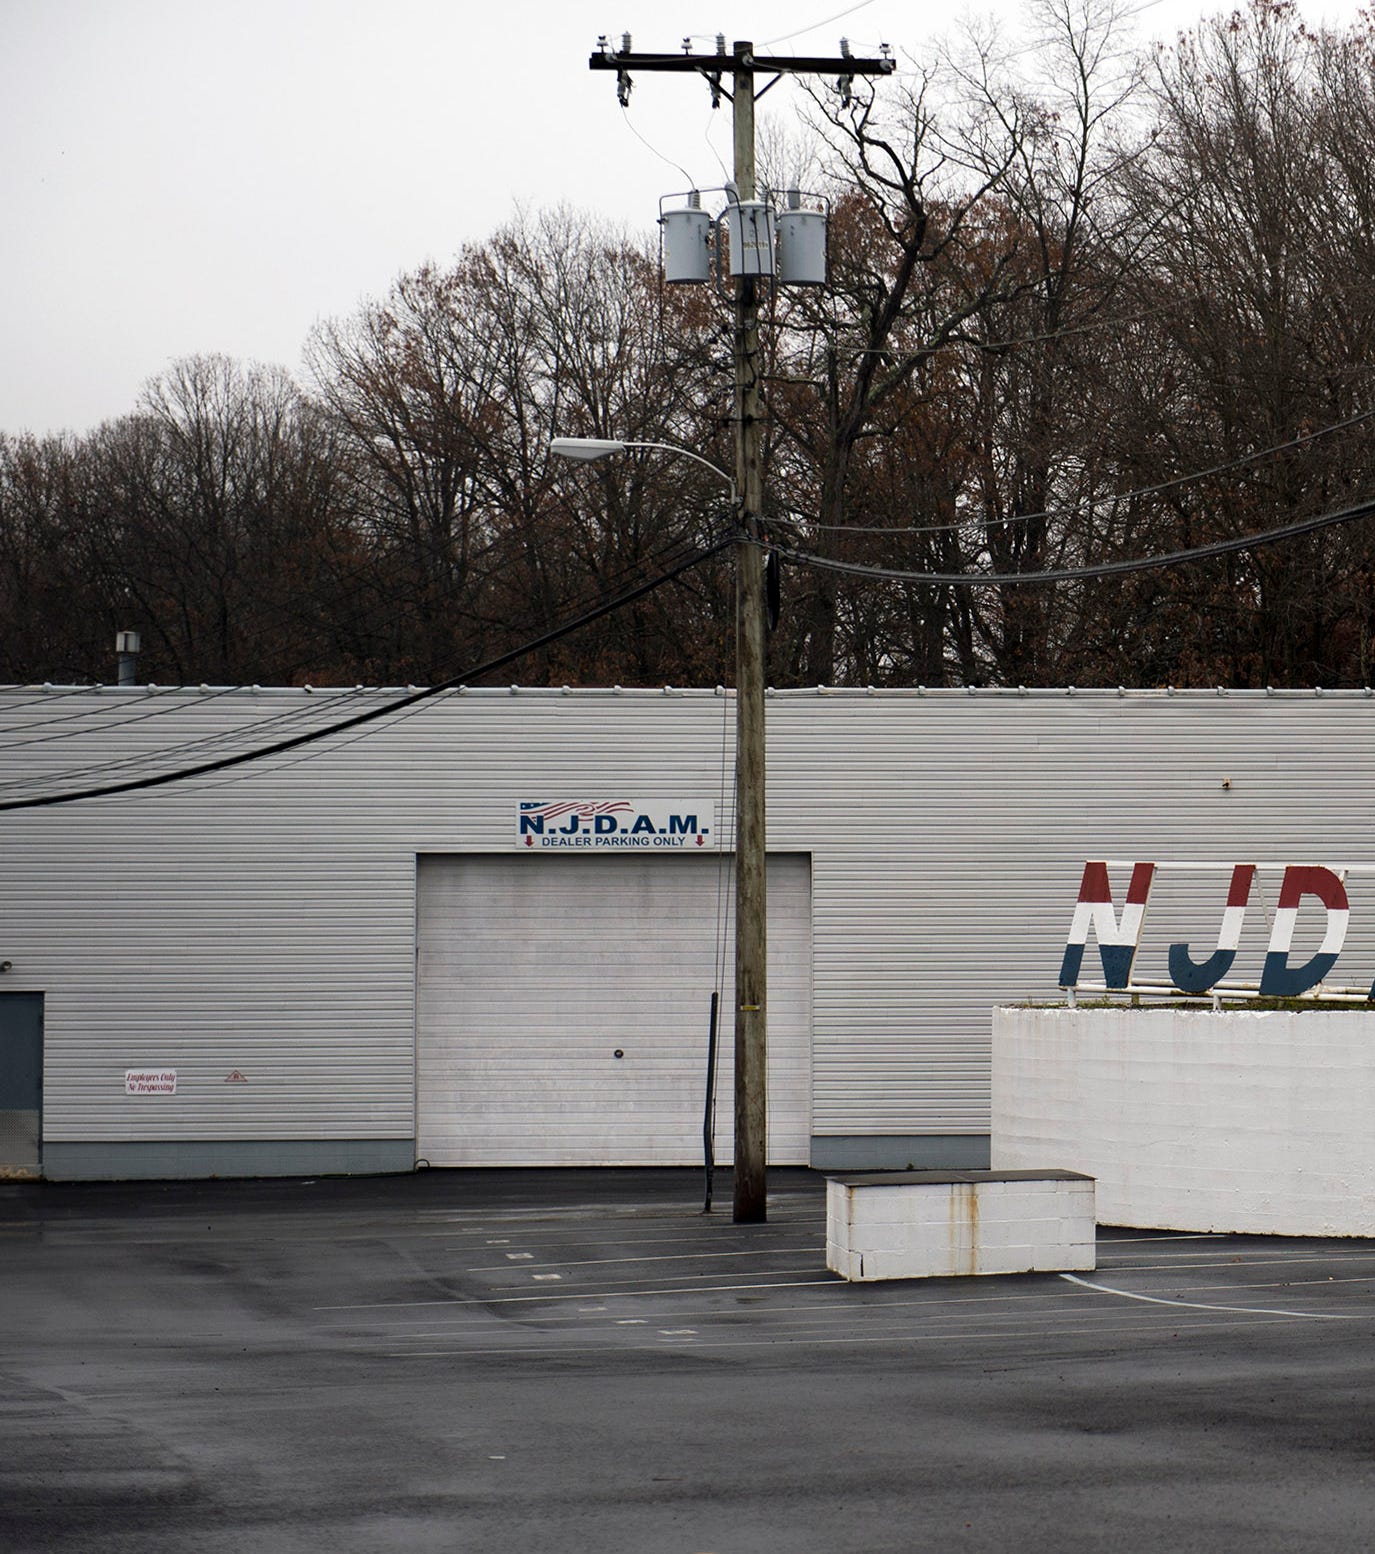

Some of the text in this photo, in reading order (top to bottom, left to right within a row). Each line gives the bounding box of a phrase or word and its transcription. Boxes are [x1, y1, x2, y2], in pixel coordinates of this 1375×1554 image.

[520, 815, 709, 835] N.J.D.A.M.
[542, 836, 685, 846] DEALER PARKING ONLY
[137, 1083, 174, 1092] Trespassing
